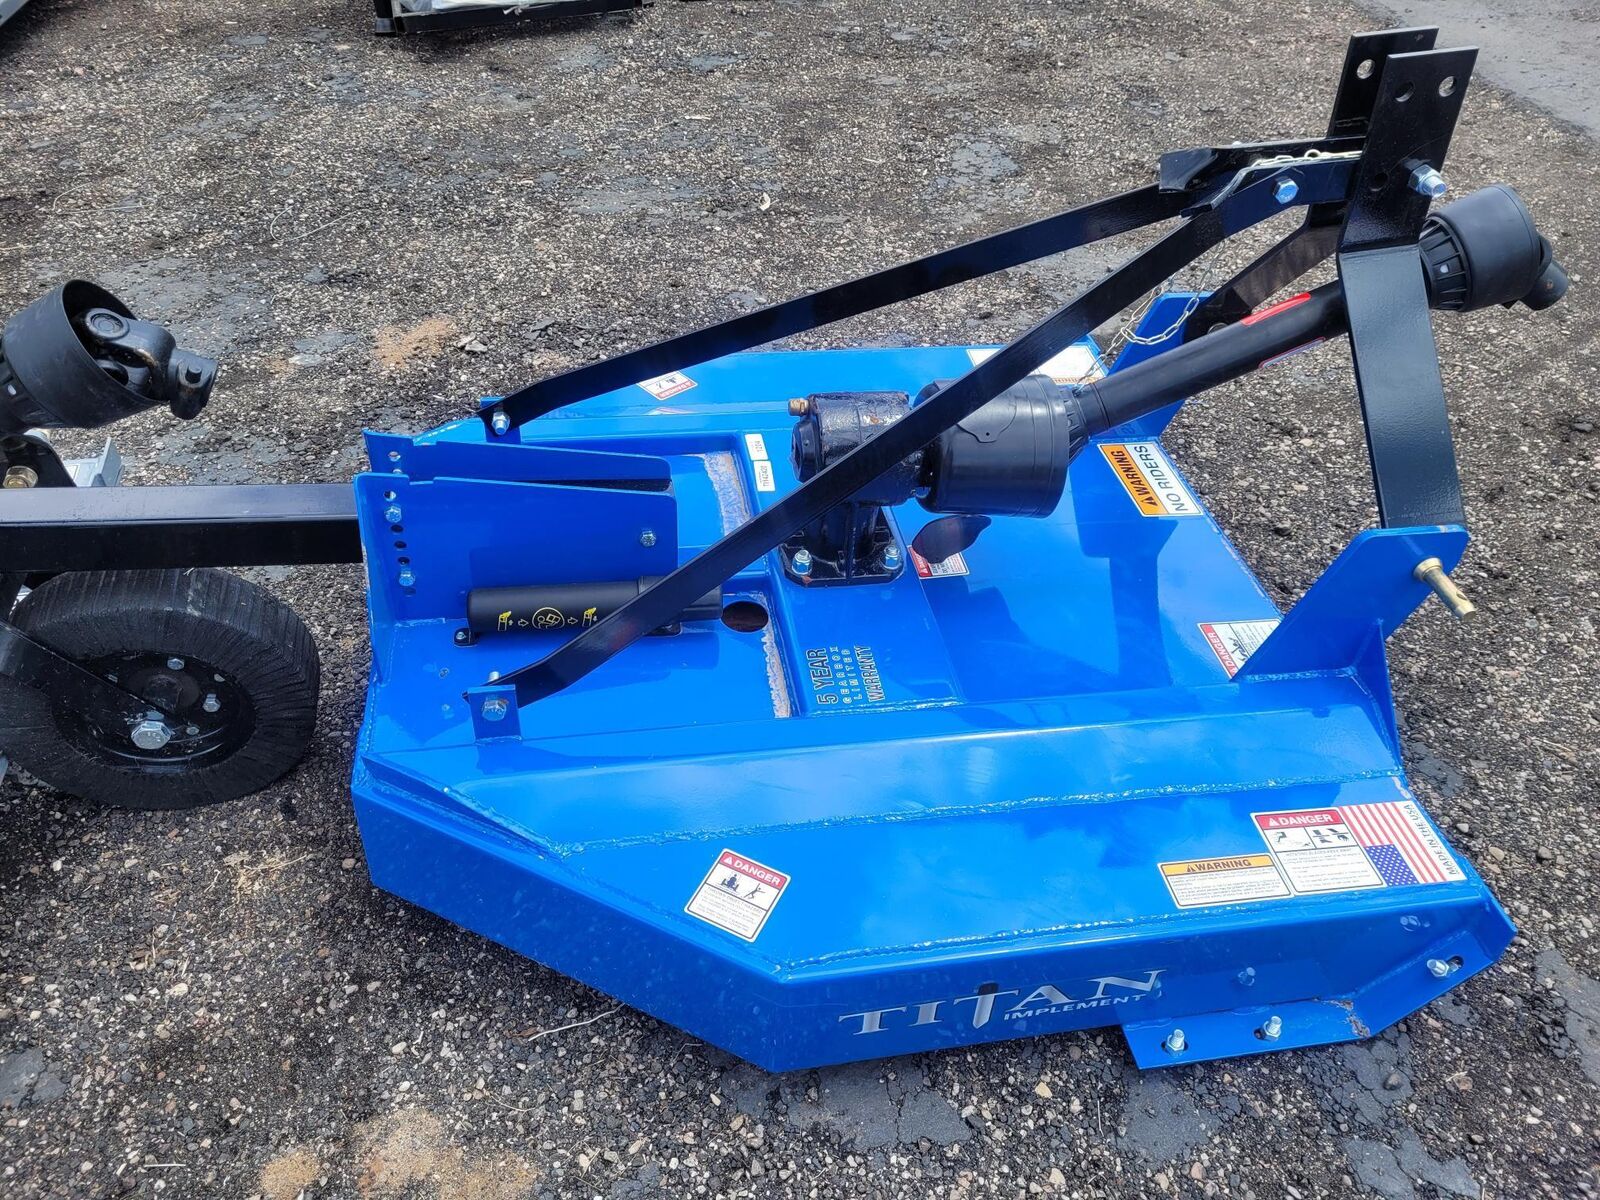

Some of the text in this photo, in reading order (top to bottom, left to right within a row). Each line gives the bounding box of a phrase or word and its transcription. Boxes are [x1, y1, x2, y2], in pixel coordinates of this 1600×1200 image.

[1111, 450, 1150, 496] WARNING
[1134, 445, 1188, 512] NO RIDERS
[829, 646, 852, 704] GEARBOX
[841, 649, 862, 700] LIMITED
[854, 645, 885, 702] WARRANTY
[1207, 632, 1237, 667] DANGER
[806, 647, 838, 705] 5 YEAR
[1278, 813, 1333, 826] DANGER
[1404, 804, 1460, 875] MADE IN THE USA
[733, 859, 781, 887] DANGER
[1195, 859, 1252, 872] WARNING
[838, 968, 1168, 1036] TITAN
[1004, 993, 1147, 1021] IMPLEMENT
